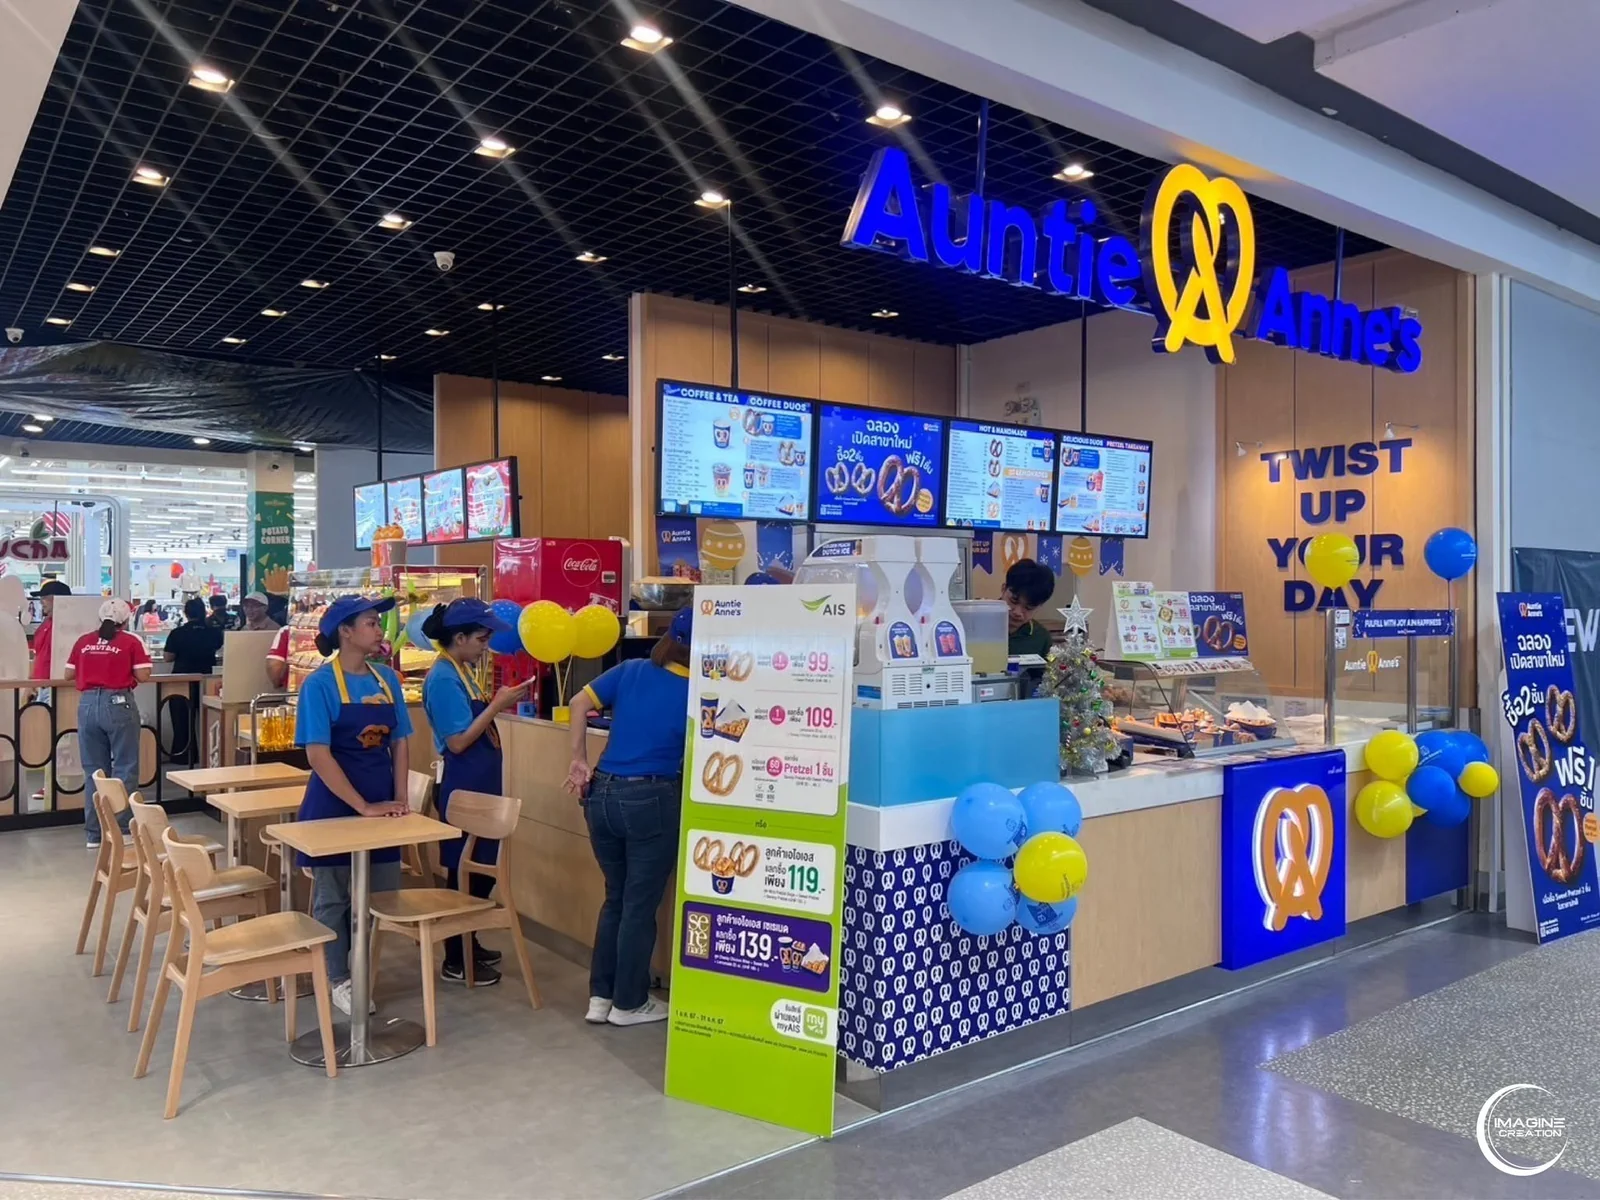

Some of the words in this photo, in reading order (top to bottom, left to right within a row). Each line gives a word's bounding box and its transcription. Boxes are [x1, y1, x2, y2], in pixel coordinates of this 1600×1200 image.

[846, 147, 1140, 305] Auntie
[1256, 266, 1423, 373] Anne's
[680, 387, 714, 401] COFFEE
[715, 392, 722, 401] &
[723, 393, 739, 403] TEA
[749, 396, 782, 409] COFFEE
[783, 401, 806, 411] DUOS
[866, 419, 899, 434] ฉลอง
[851, 431, 913, 449] เปิดสาขาใหม่
[1063, 435, 1089, 445] DELICIOUS
[1260, 438, 1412, 483] TWIST
[1300, 489, 1366, 525] UP
[261, 525, 289, 536] POTATO
[261, 536, 290, 545] CORNER
[822, 548, 840, 556] DUTCH
[841, 547, 850, 555] ICE
[1190, 595, 1215, 603] ฉลอง
[1284, 579, 1384, 612] DAY
[714, 599, 742, 609] Auntie
[823, 604, 846, 616] AIS
[714, 608, 742, 617] Anne's
[1517, 634, 1551, 652] ฉลอง
[1344, 658, 1366, 671] Auntie
[1510, 649, 1565, 670] เปิดสาขาใหม่
[784, 763, 813, 776] Pretzel
[816, 762, 821, 776] 1
[822, 761, 834, 777] ชิ้น
[755, 819, 767, 830] หรือ
[765, 846, 814, 863] ลูกค้าเอไอเอส
[765, 863, 787, 875] แลกซื้อ
[764, 874, 786, 888] เพียง
[716, 913, 761, 931] ลูกค้าเอไอเอส
[715, 928, 737, 941] แลกซื้อ
[715, 939, 736, 955] เพียง
[777, 1022, 801, 1034] myAIS
[806, 1014, 825, 1029] my
